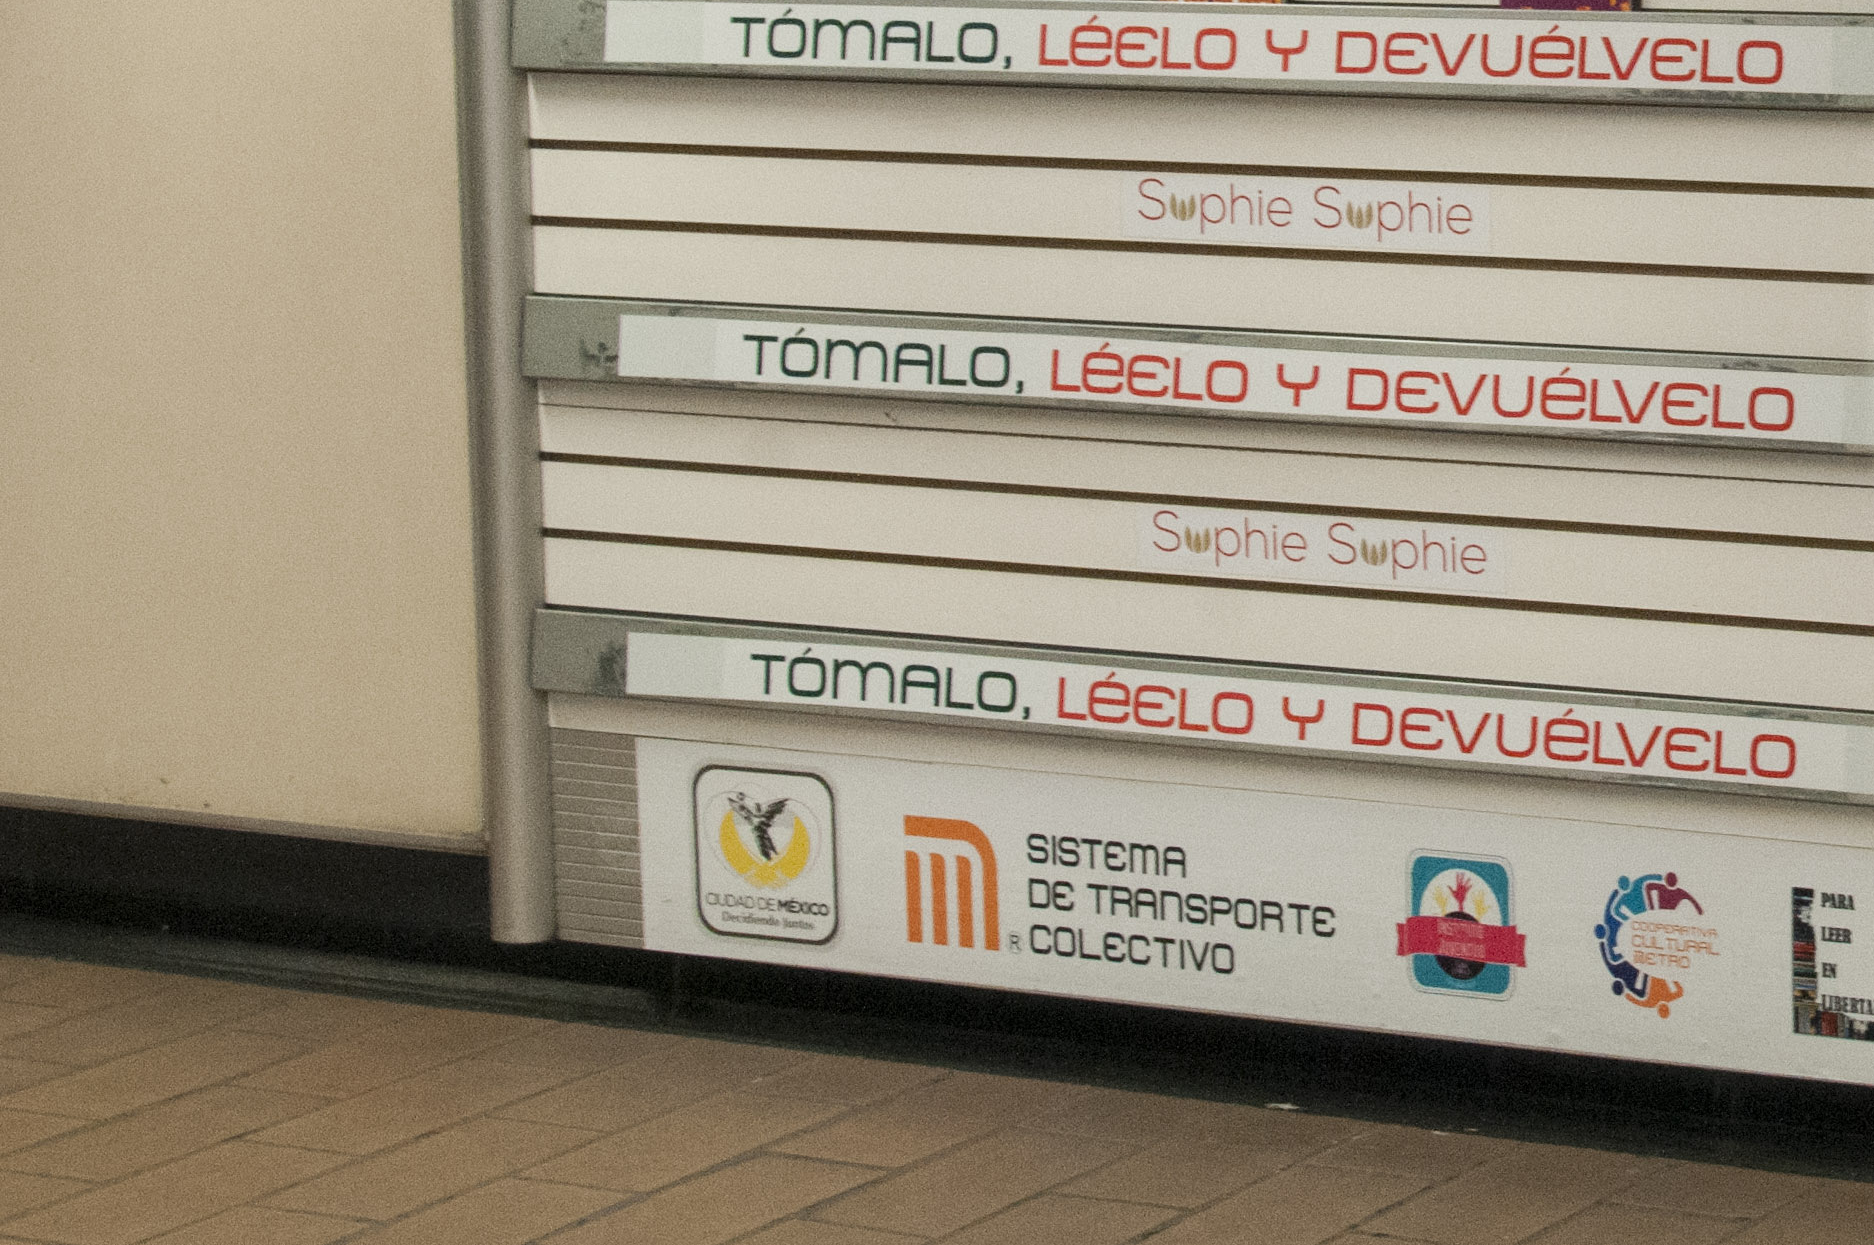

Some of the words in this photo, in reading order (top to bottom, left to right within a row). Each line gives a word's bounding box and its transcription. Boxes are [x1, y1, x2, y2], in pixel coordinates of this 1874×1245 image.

[731, 9, 1013, 70] TÓMALO,
[1039, 16, 1236, 70] LÉELO
[1266, 30, 1308, 71] Y
[1336, 26, 1783, 84] DEVUÉLVELO
[743, 326, 1025, 395] TÓMALO,
[1052, 343, 1248, 403] LÉELO
[1277, 364, 1319, 406] Y
[1346, 366, 1796, 433] DEVUÉLVELO
[750, 647, 1032, 721] TÓMALO,
[1058, 672, 1253, 734] LÉELO
[1283, 697, 1324, 740] Y
[1350, 702, 1798, 780] DEVUÉLVELO
[1028, 834, 1186, 877] SISTEMA
[778, 899, 829, 916] MÉXICO
[1029, 878, 1074, 911] DE
[1087, 883, 1335, 937] TRANSPORTE
[1820, 892, 1856, 910] PARA
[1030, 924, 1234, 974] COLECTIVO
[1631, 934, 1720, 956] CULTURAL
[1820, 926, 1852, 944] LEER
[1821, 962, 1837, 979] EN
